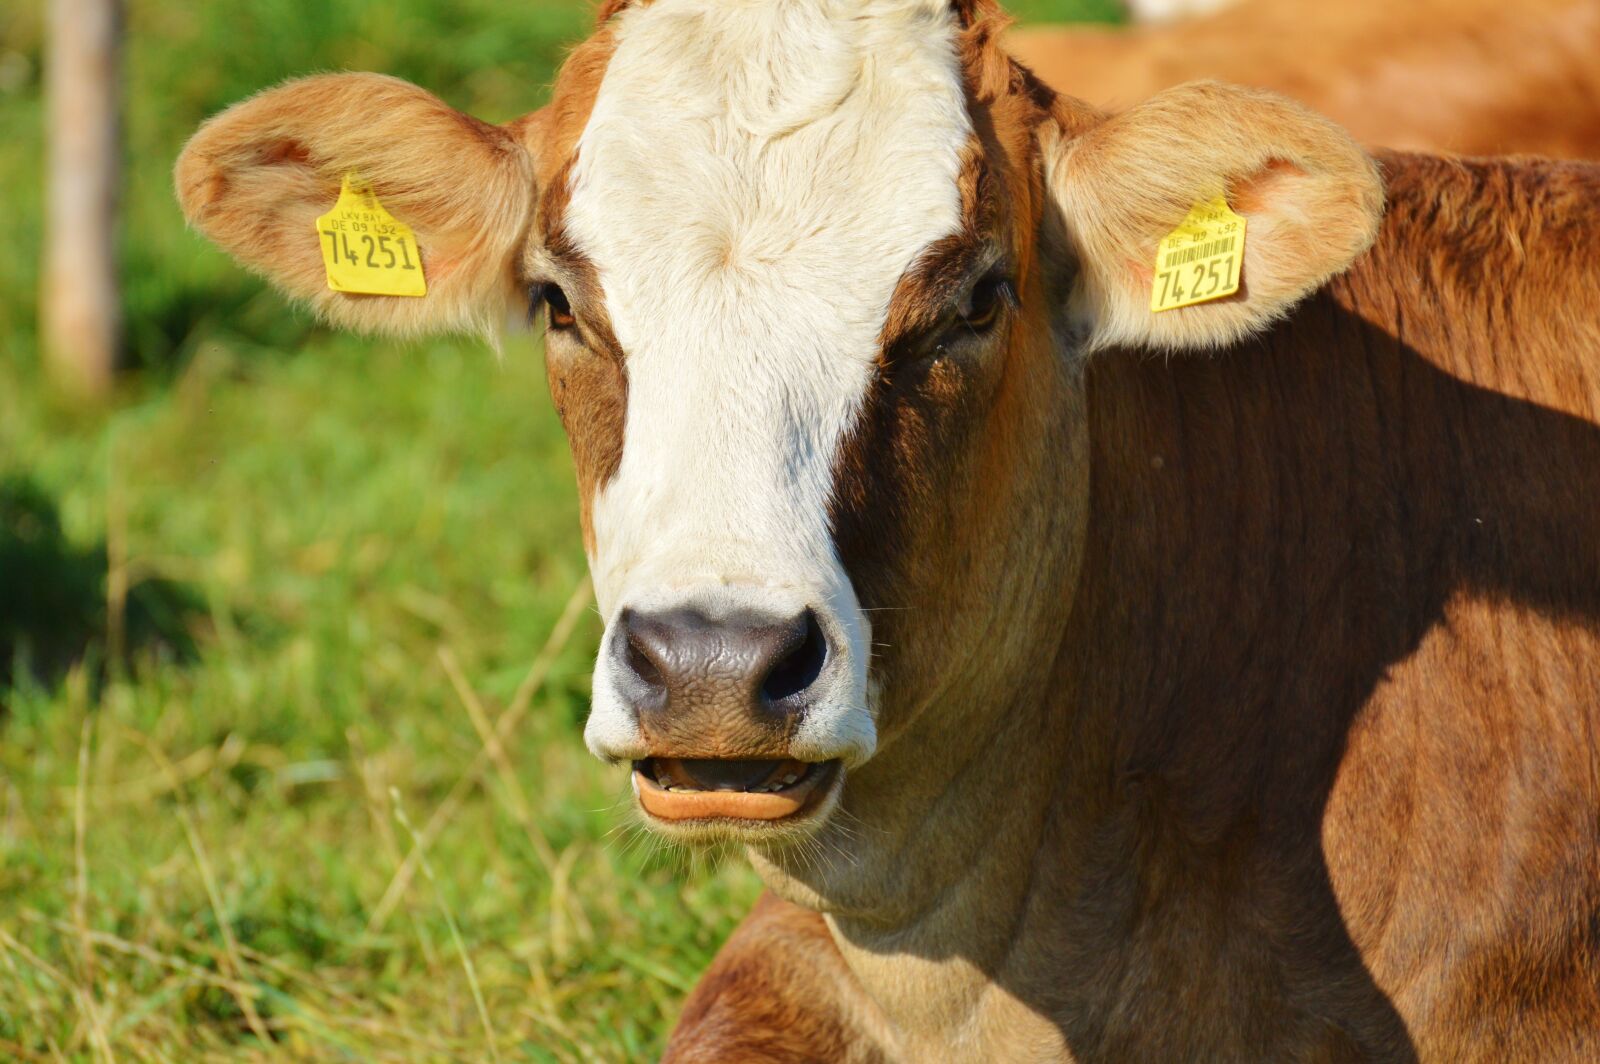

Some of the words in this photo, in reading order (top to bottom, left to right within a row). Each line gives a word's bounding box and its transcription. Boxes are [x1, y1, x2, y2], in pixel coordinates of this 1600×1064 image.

[331, 219, 347, 231] DE
[352, 222, 368, 232] 09
[1168, 237, 1183, 249] DE
[1193, 231, 1207, 242] 09
[323, 230, 359, 266] 74
[361, 234, 417, 270] 251
[1158, 269, 1185, 307] 74
[1190, 255, 1235, 299] 251
